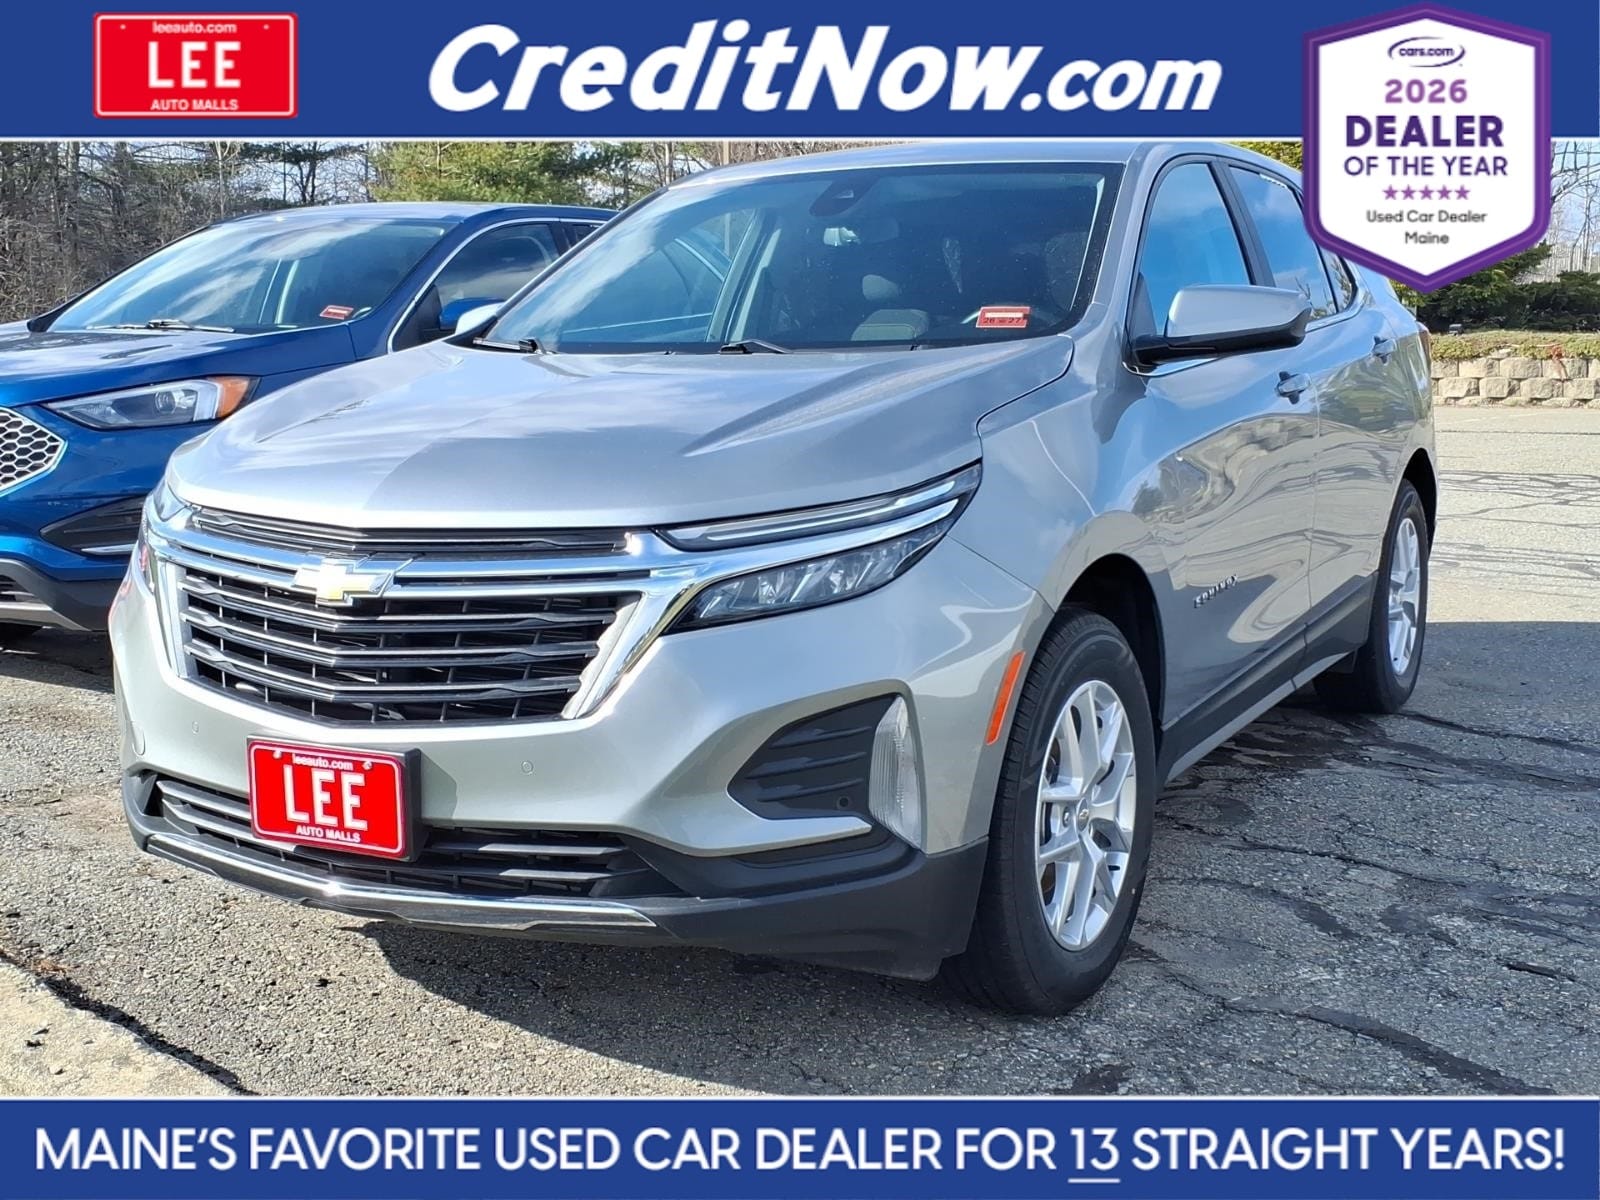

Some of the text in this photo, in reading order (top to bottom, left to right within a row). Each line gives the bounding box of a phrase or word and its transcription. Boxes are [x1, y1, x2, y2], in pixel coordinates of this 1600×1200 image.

[291, 753, 354, 772] leeauto.com
[283, 764, 368, 831] LEE
[295, 825, 361, 843] AUTO MALLS
